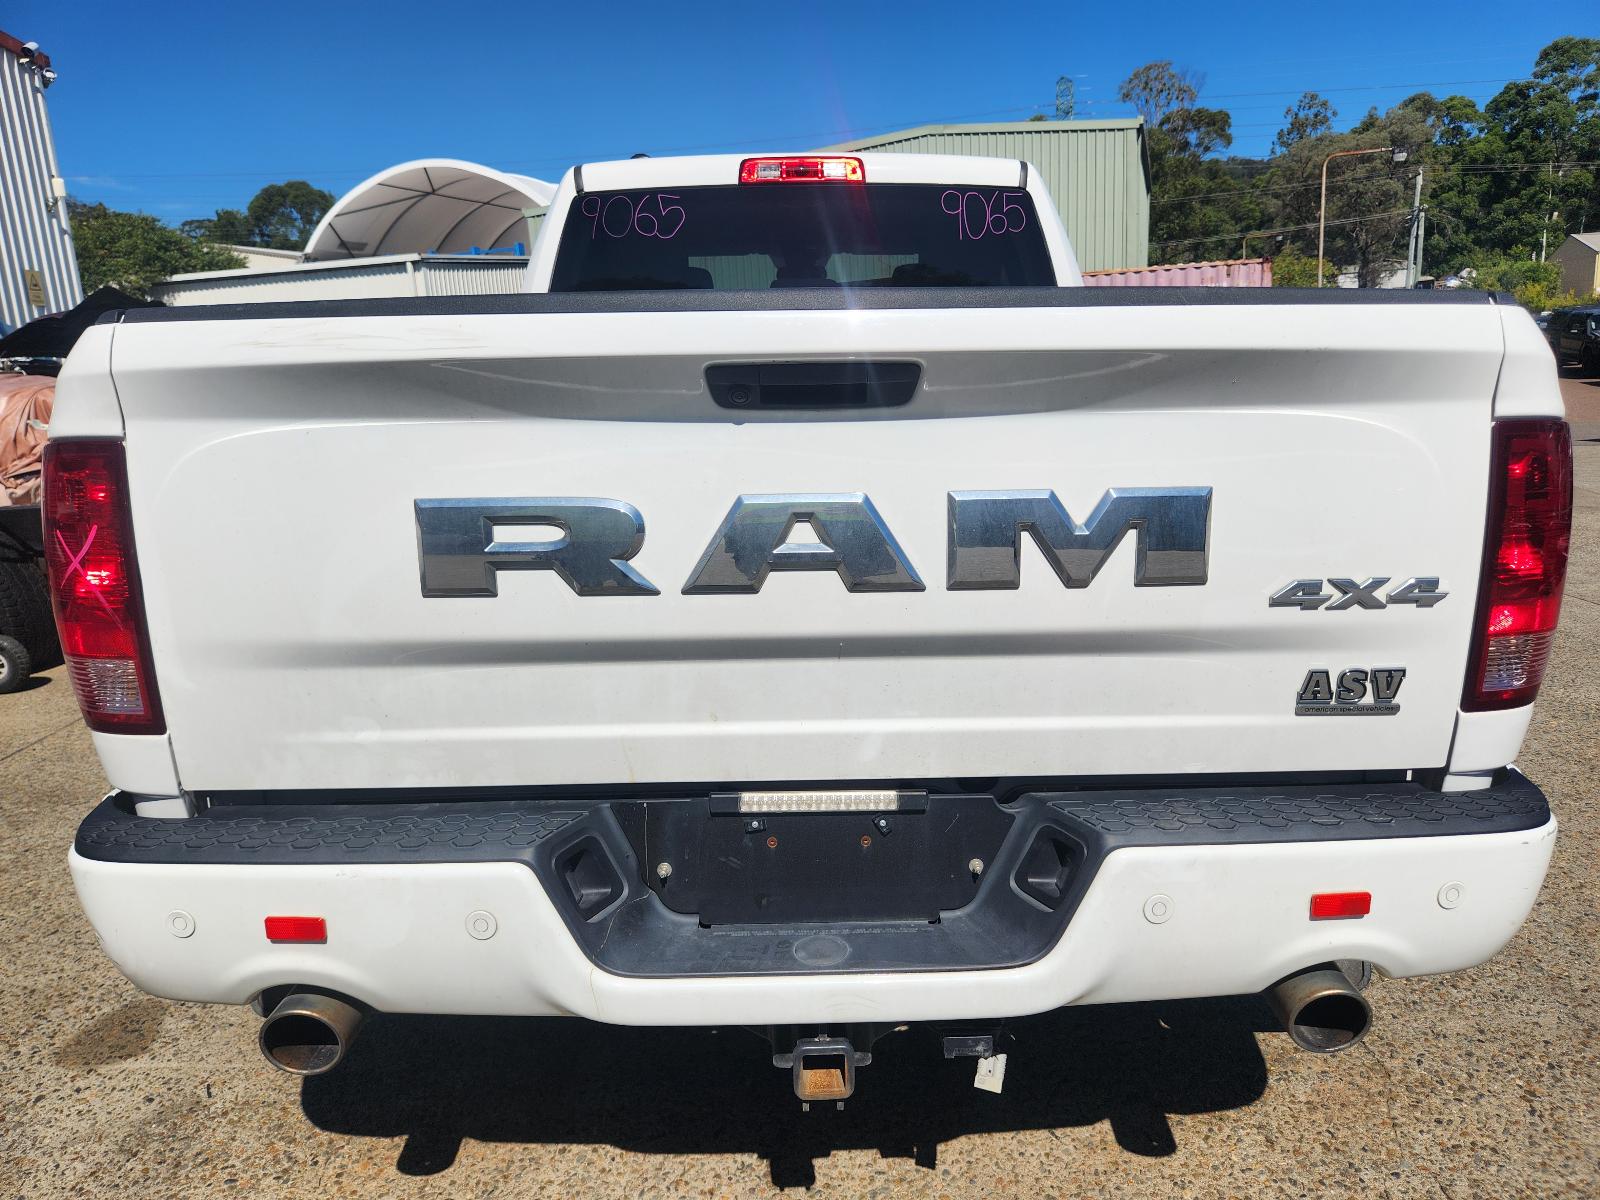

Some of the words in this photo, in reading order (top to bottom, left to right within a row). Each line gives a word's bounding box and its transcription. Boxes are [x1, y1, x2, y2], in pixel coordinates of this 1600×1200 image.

[581, 194, 686, 240] 9065
[940, 189, 1026, 241] 9065
[413, 485, 1214, 598] RAM
[1296, 667, 1407, 704] ASV
[1339, 705, 1364, 714] special
